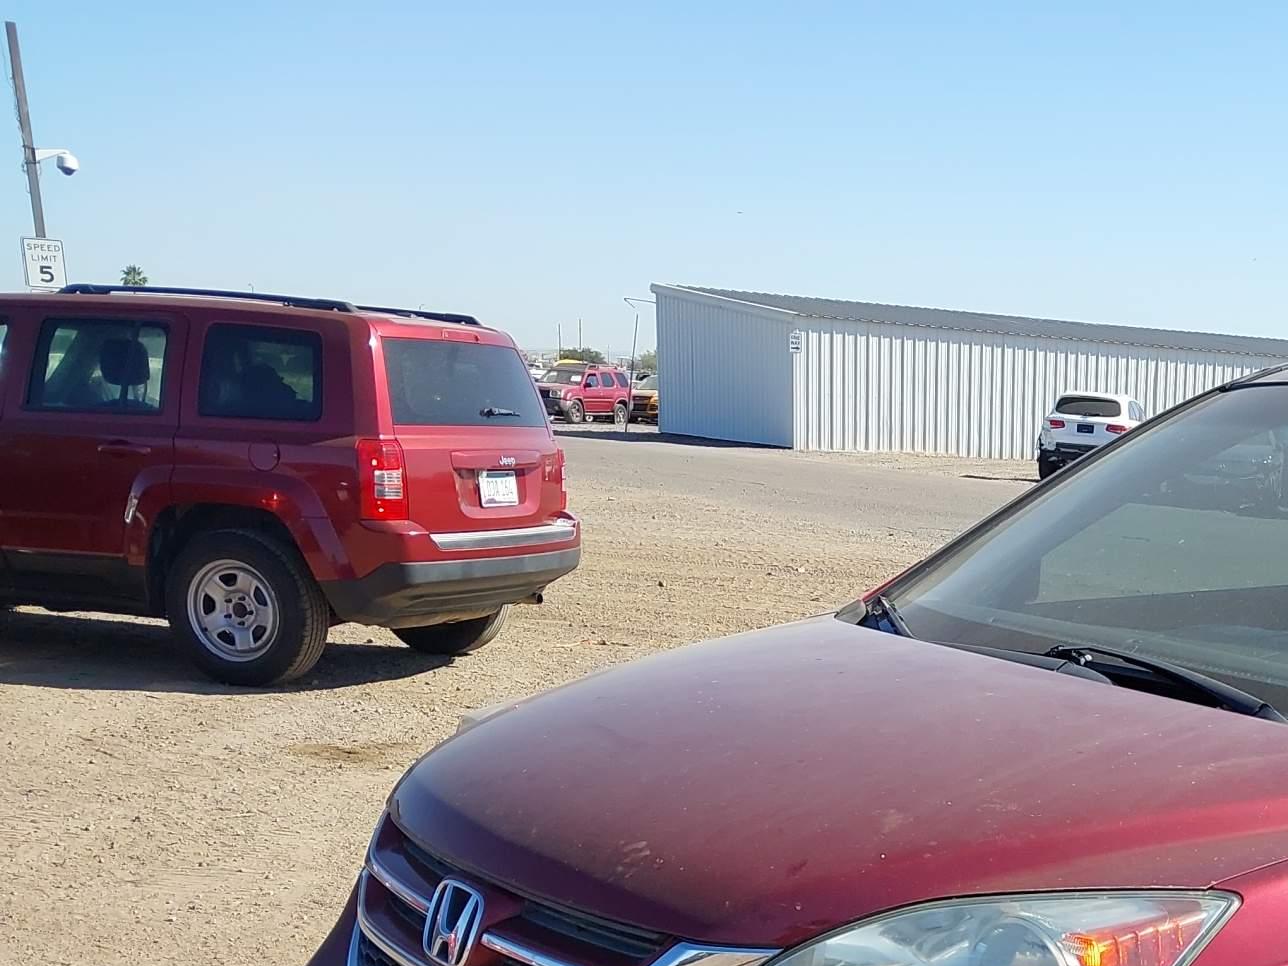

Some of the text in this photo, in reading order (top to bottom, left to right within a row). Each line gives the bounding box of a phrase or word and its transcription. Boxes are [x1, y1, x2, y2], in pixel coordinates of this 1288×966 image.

[26, 243, 61, 252] SPEED
[31, 254, 57, 263] LIMIT
[39, 265, 55, 283] 5
[498, 455, 516, 467] Jeep
